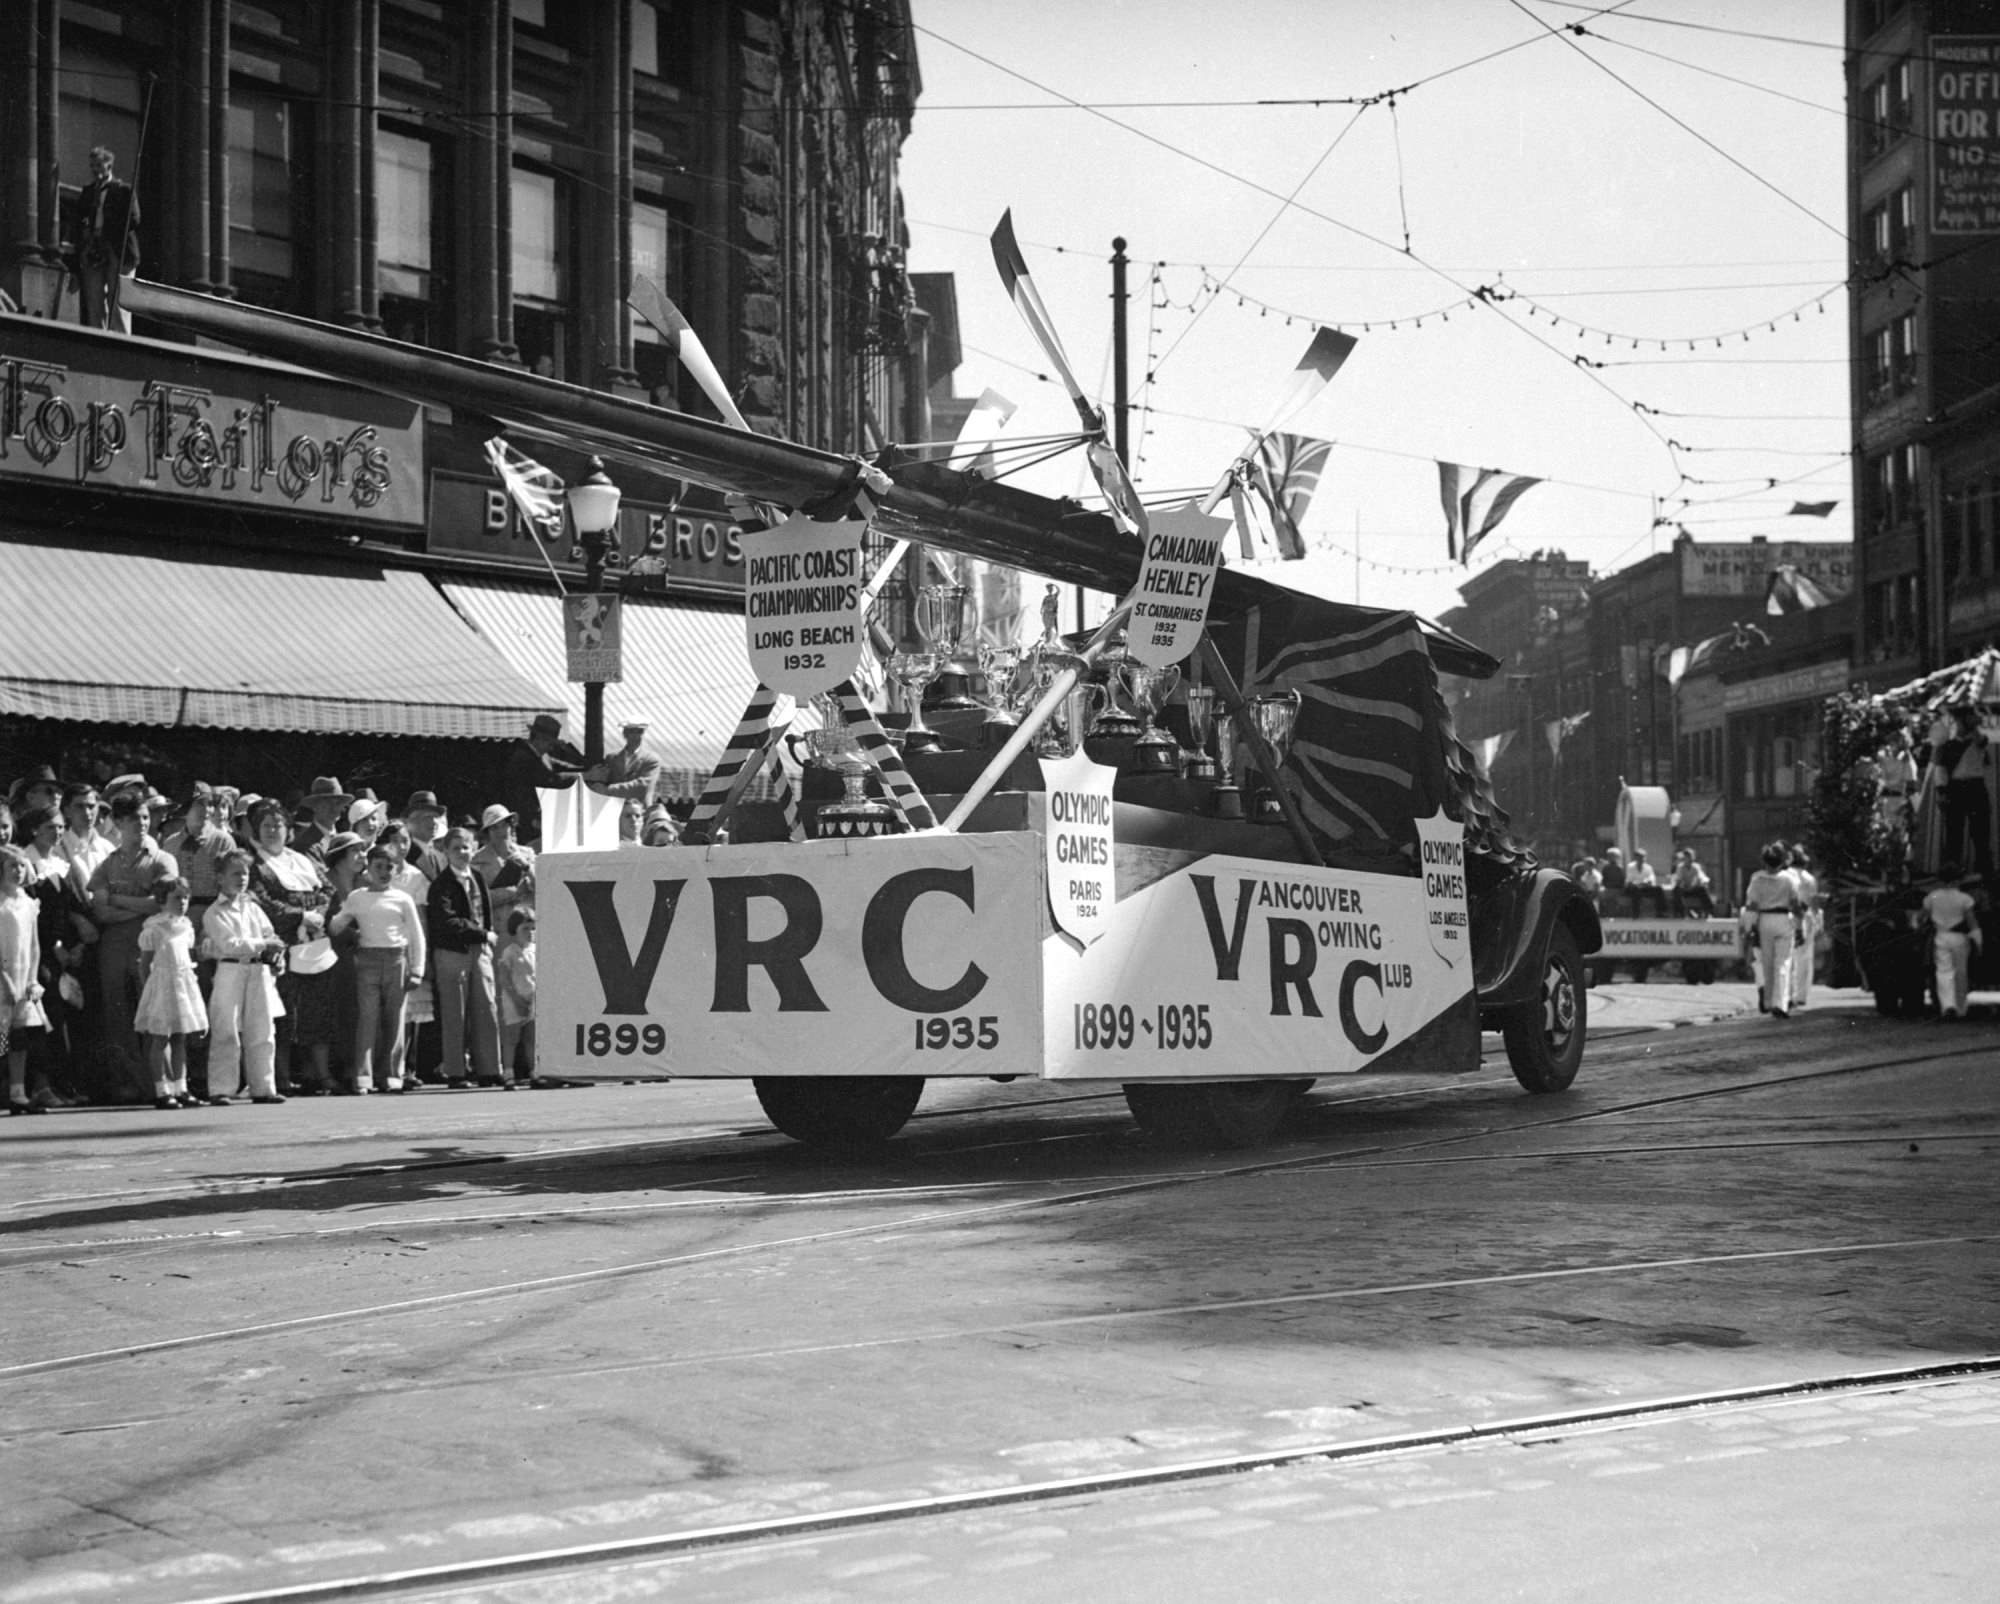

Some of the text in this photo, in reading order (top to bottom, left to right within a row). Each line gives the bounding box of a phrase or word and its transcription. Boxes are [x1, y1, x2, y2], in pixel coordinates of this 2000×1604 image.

[1937, 109, 1988, 138] FOR
[0, 354, 394, 493] Top Tailors
[1148, 534, 1219, 567] CANADIAN
[750, 548, 857, 586] PACIFIC COAST
[1143, 568, 1211, 598] HENLEY
[749, 584, 857, 618] CHAMPIONSHIPS
[1148, 604, 1204, 622] CATHARINES
[755, 625, 855, 650] LONG BEACH
[1151, 634, 1175, 647] 1935
[1154, 621, 1177, 633] 1932
[784, 653, 826, 670] 1932
[1051, 790, 1110, 826] OLYMPIC
[1056, 833, 1109, 866] GAMES
[1423, 839, 1462, 867] OLYMPIC
[1069, 879, 1102, 901] PARIS
[1426, 873, 1464, 899] GAMES
[1076, 904, 1098, 918] 1924
[1429, 911, 1468, 927] LOS ANGELES
[1189, 873, 1363, 981] VANCOUVER
[1603, 929, 1734, 946] VOCATIONAL GUIDANCE
[1267, 916, 1383, 1018] ROWING
[1338, 958, 1413, 1055] CLUB
[575, 1015, 1000, 1057] 1899 1935
